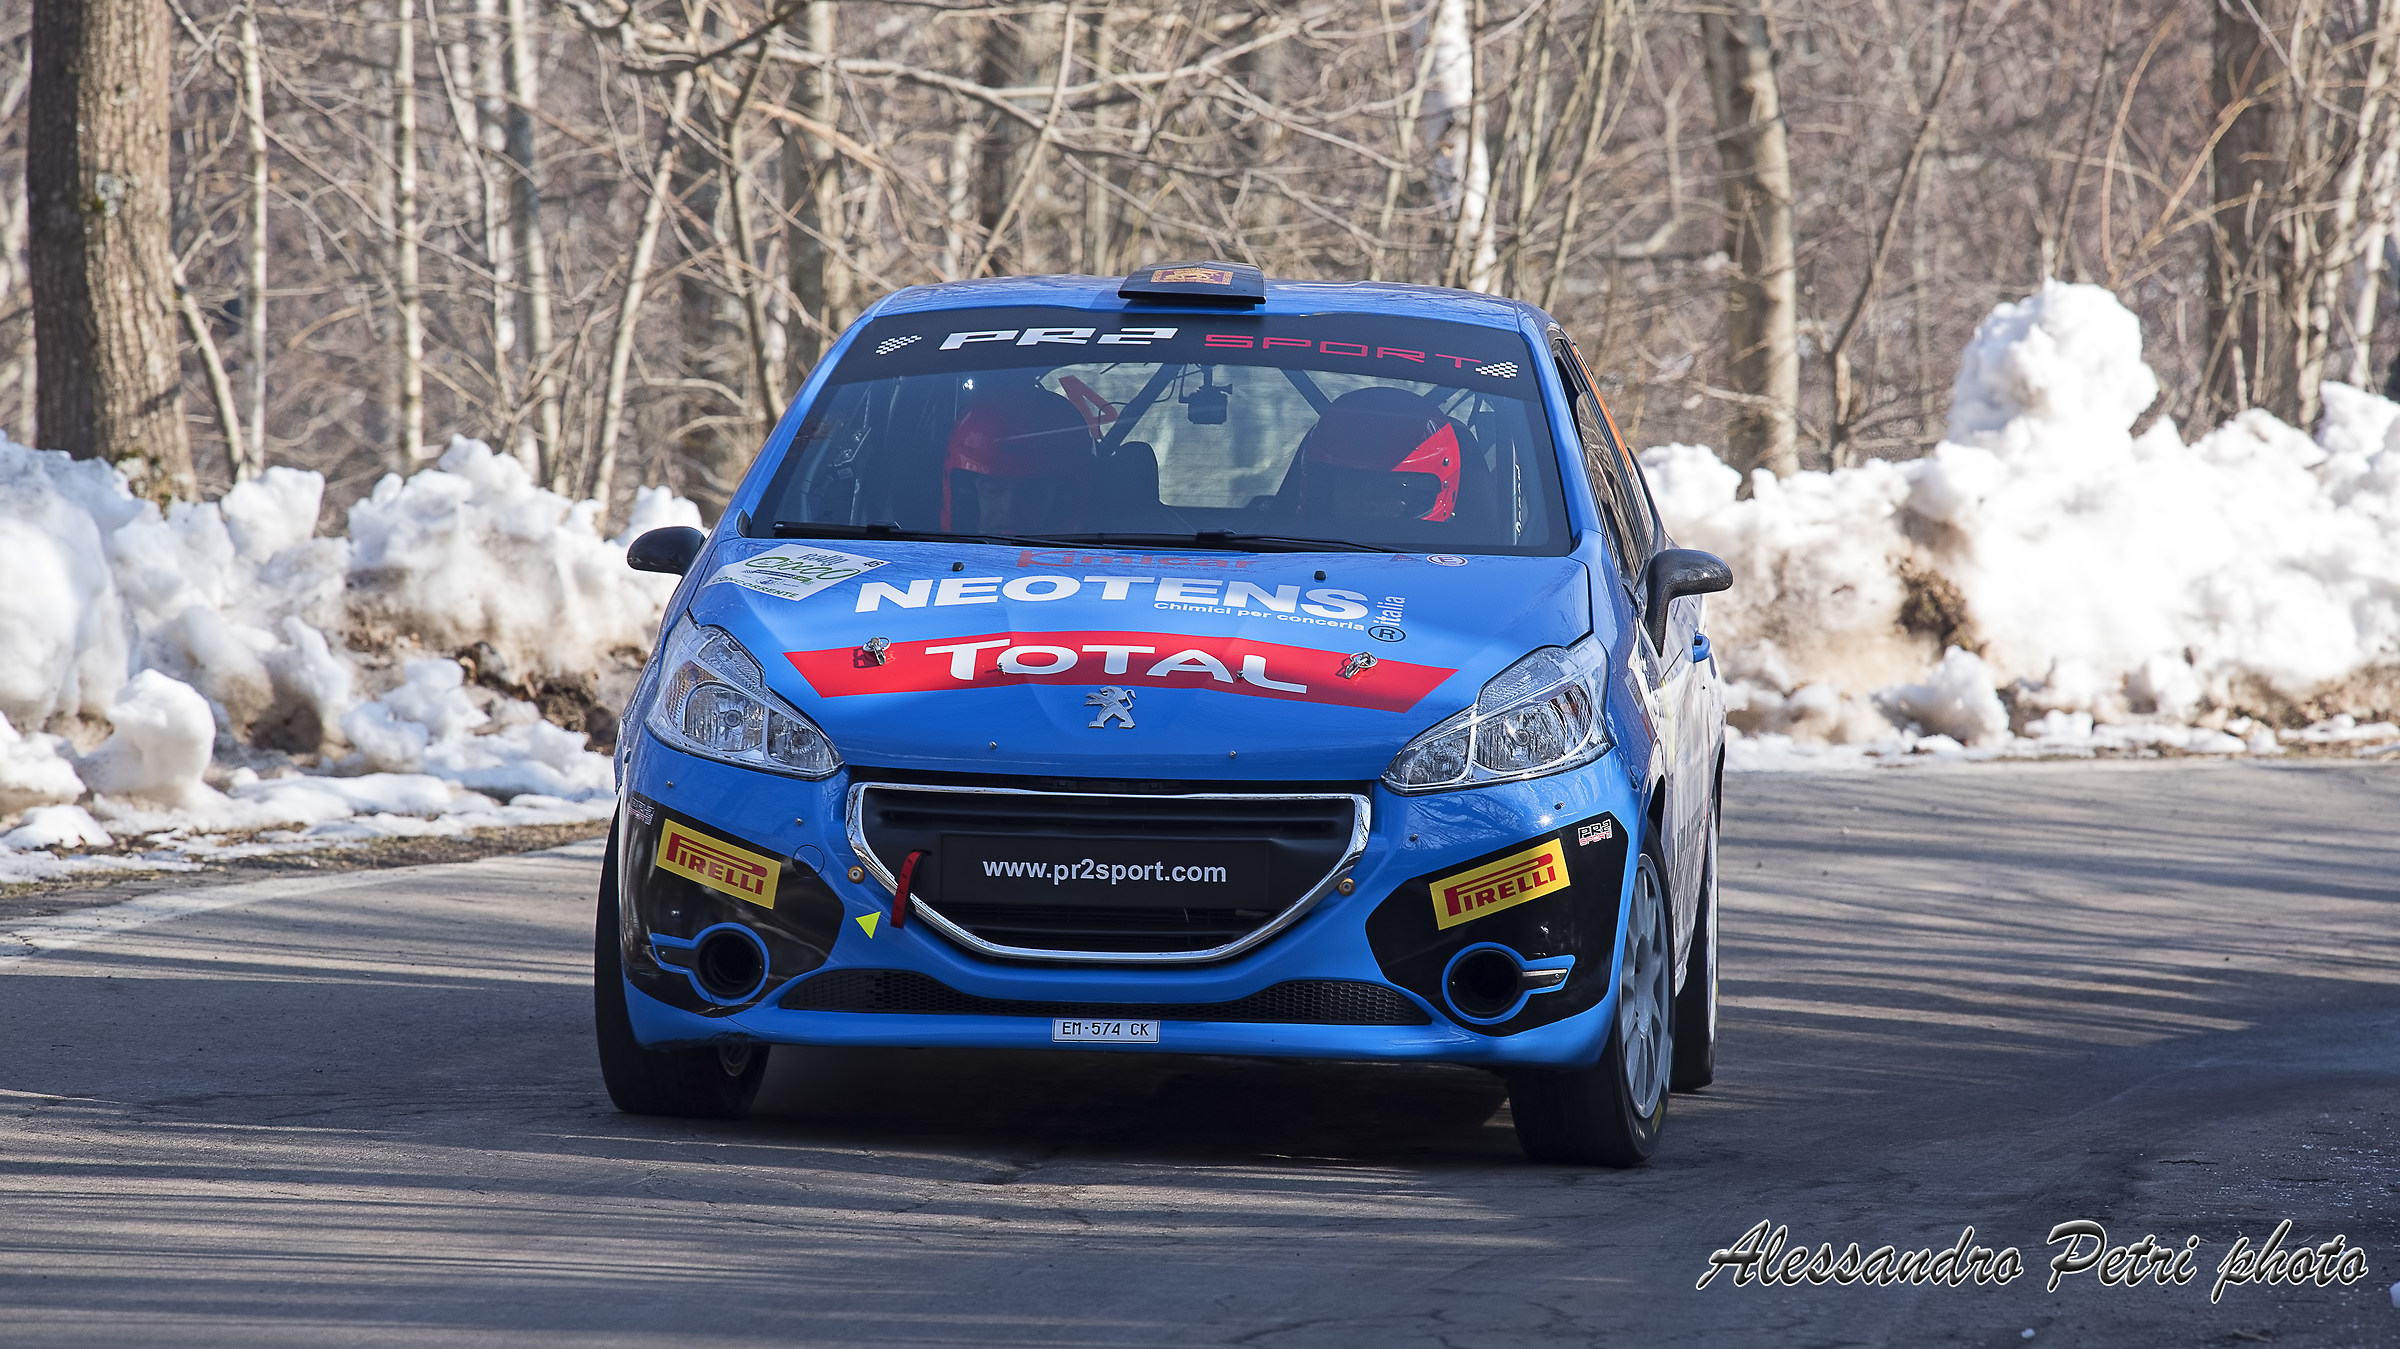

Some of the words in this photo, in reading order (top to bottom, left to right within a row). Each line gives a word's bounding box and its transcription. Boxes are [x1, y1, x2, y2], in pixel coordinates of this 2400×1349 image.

[938, 327, 1179, 350] PR2
[1204, 334, 1482, 369] SPORT
[1016, 550, 1257, 569] Kimicar
[855, 575, 1369, 620] NEOTENS
[1372, 595, 1407, 627] italia
[1153, 602, 1231, 615] Chimici
[1237, 608, 1272, 620] per
[1276, 613, 1365, 632] conceria
[924, 638, 1308, 694] TOTAL
[666, 831, 768, 896] PIRELLI
[982, 857, 1227, 886] www.pr2sport.com
[1443, 852, 1557, 918] PIRELLI
[1129, 1022, 1150, 1037] CK
